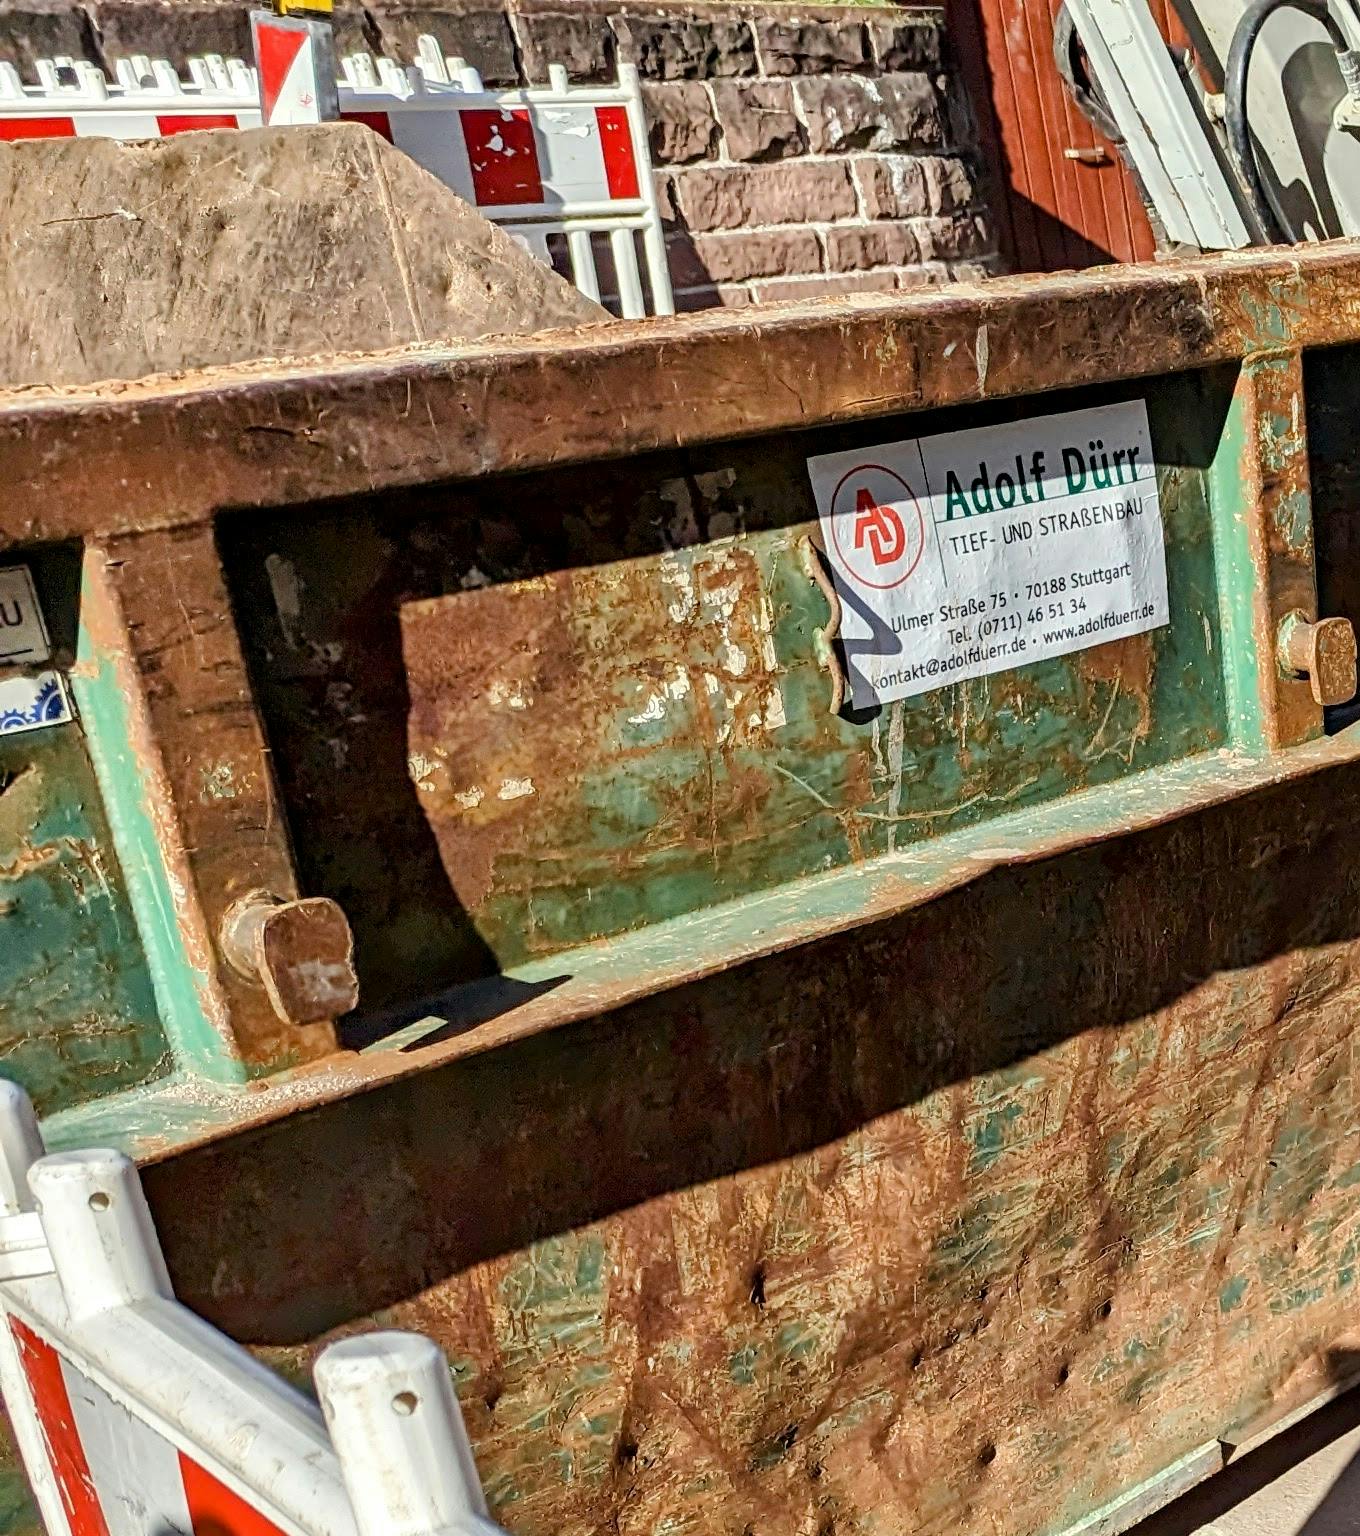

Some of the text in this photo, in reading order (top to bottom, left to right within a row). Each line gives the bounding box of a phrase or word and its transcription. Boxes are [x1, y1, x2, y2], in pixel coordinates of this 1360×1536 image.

[945, 439, 1141, 521] Adolf Dürr
[853, 487, 907, 567] AD
[949, 530, 997, 556] TIEF-
[1002, 521, 1033, 546] UND
[890, 561, 1132, 634] Ulmer Straße 75 70188 Stuttgart
[947, 597, 1088, 648] Tel. (0711) 46 51 34
[870, 601, 1156, 691] kontakt@adolfduerr.de www.adolfduerr.de
